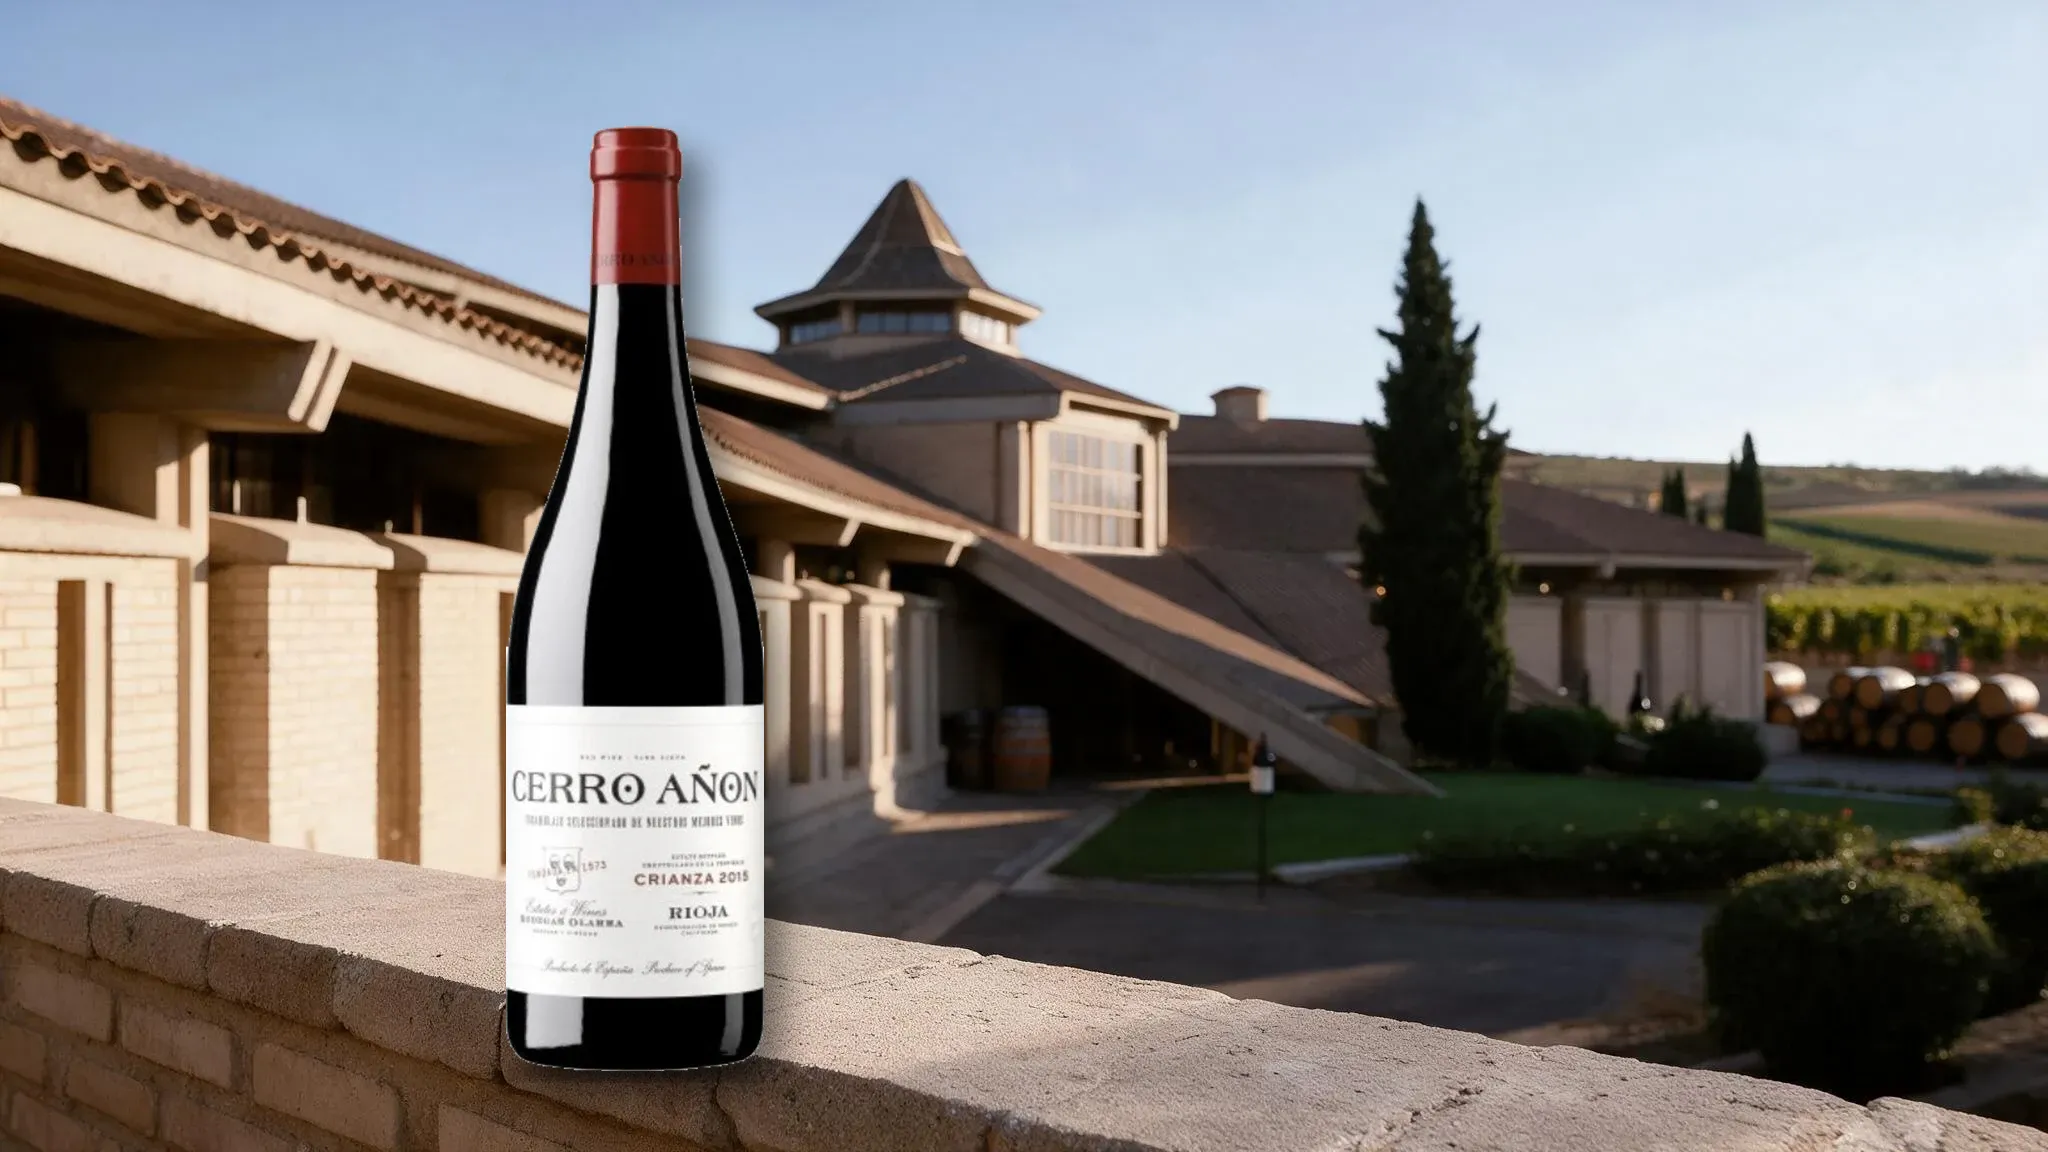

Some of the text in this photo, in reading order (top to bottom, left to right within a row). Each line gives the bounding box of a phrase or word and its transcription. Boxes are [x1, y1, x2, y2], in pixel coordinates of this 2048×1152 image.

[512, 769, 645, 806] CERRO
[631, 816, 642, 829] DE
[634, 870, 750, 886] CRIANZA 2015
[668, 904, 728, 919] RIOJA
